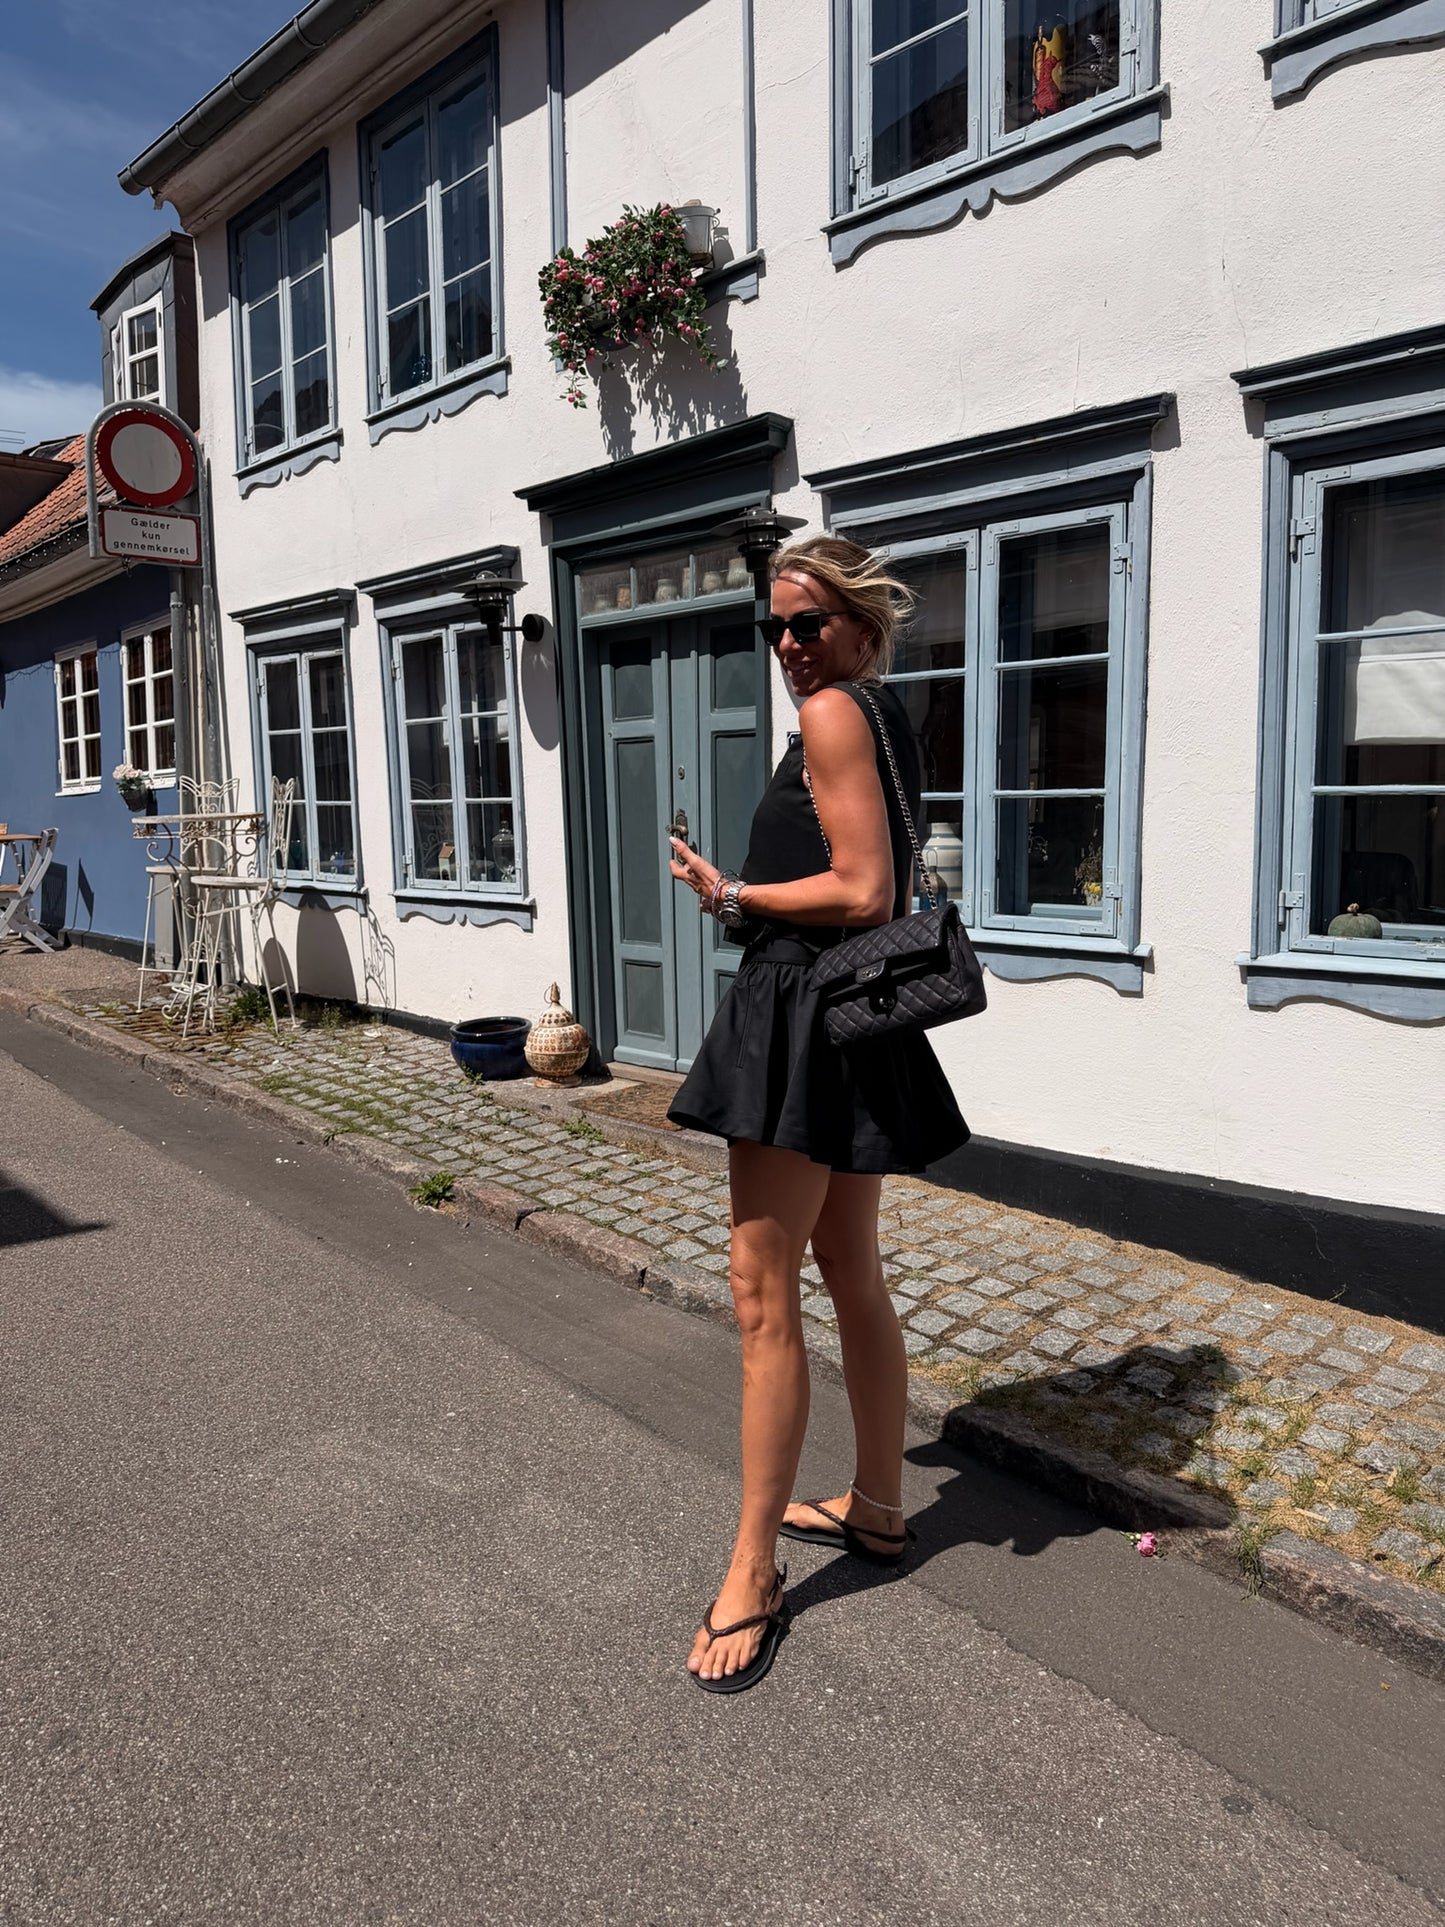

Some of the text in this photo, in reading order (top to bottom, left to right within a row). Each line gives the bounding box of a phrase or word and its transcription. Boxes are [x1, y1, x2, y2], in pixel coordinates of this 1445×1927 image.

[131, 518, 171, 530] Gælder
[142, 531, 161, 540] kun
[113, 541, 190, 555] gennemkørsel
